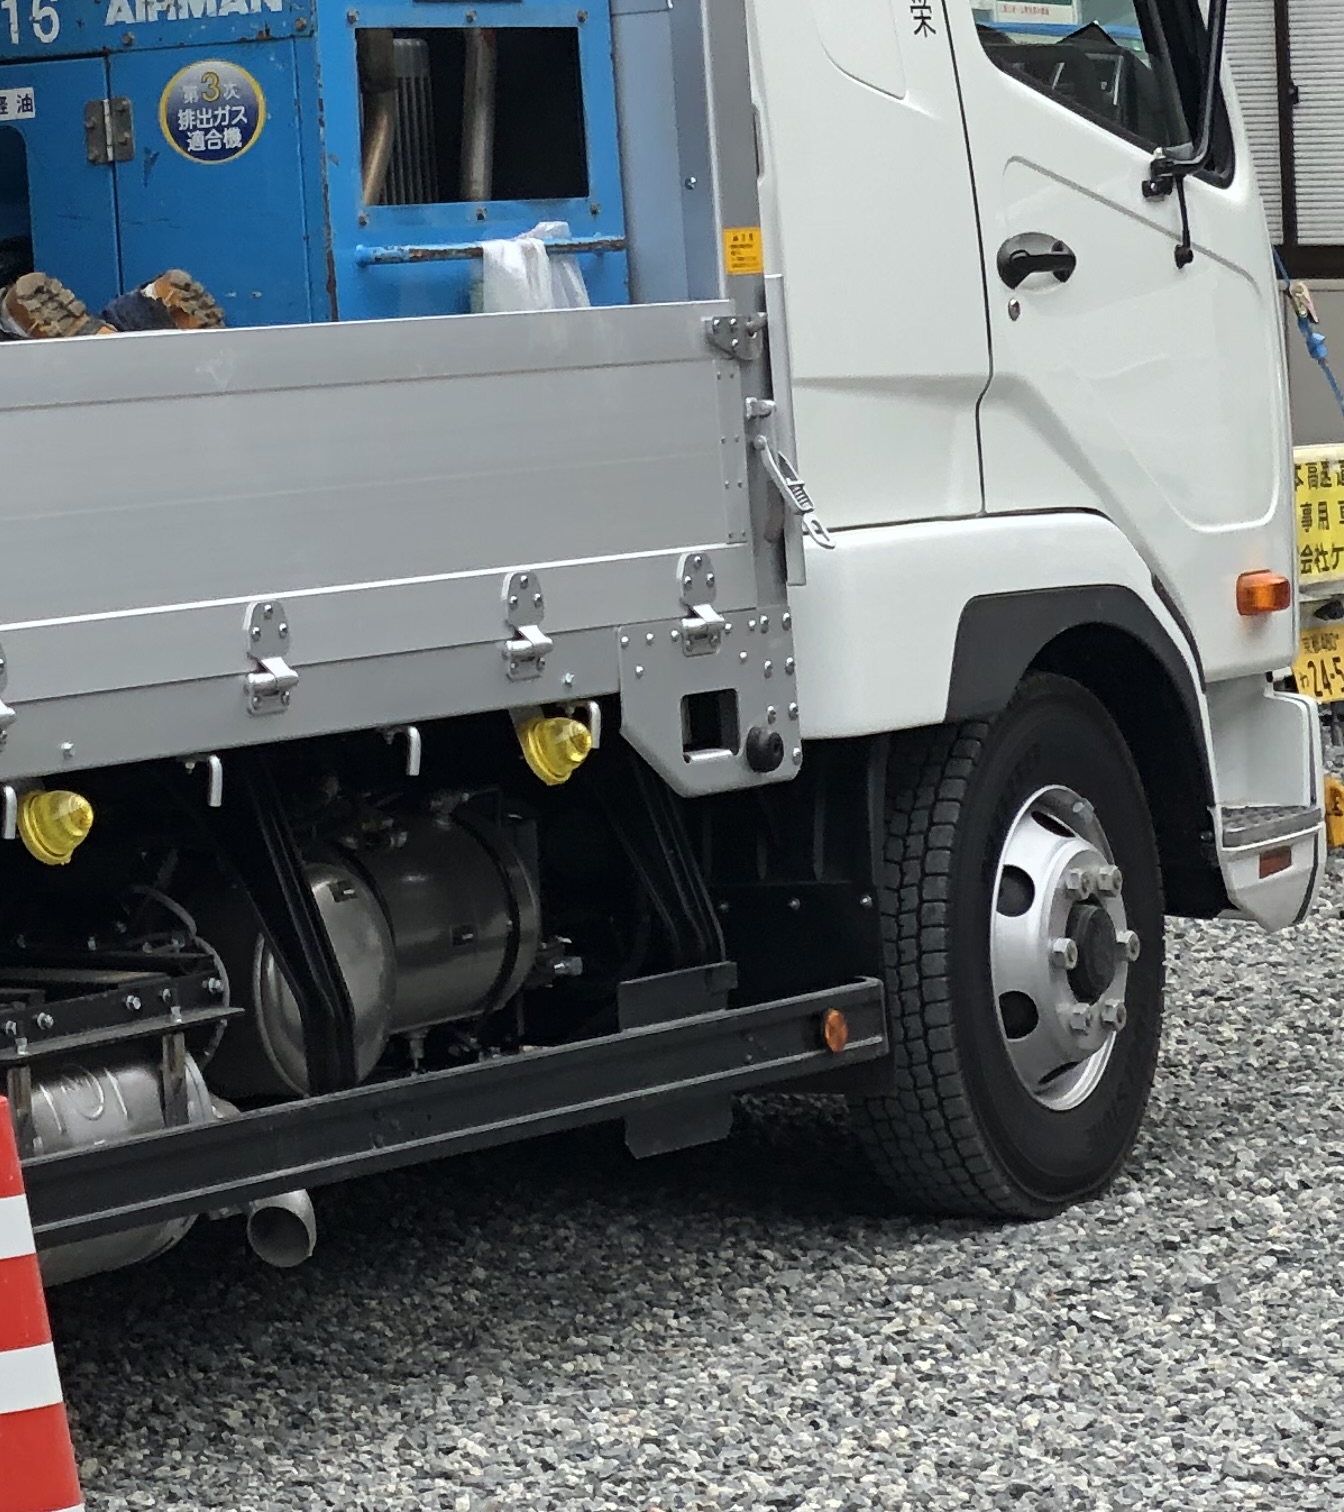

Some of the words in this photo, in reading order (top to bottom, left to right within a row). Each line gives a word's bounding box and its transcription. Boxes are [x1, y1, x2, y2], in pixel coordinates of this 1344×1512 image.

[181, 71, 241, 104] 第3次
[178, 104, 248, 131] 排出ガス
[187, 127, 243, 152] 適合機
